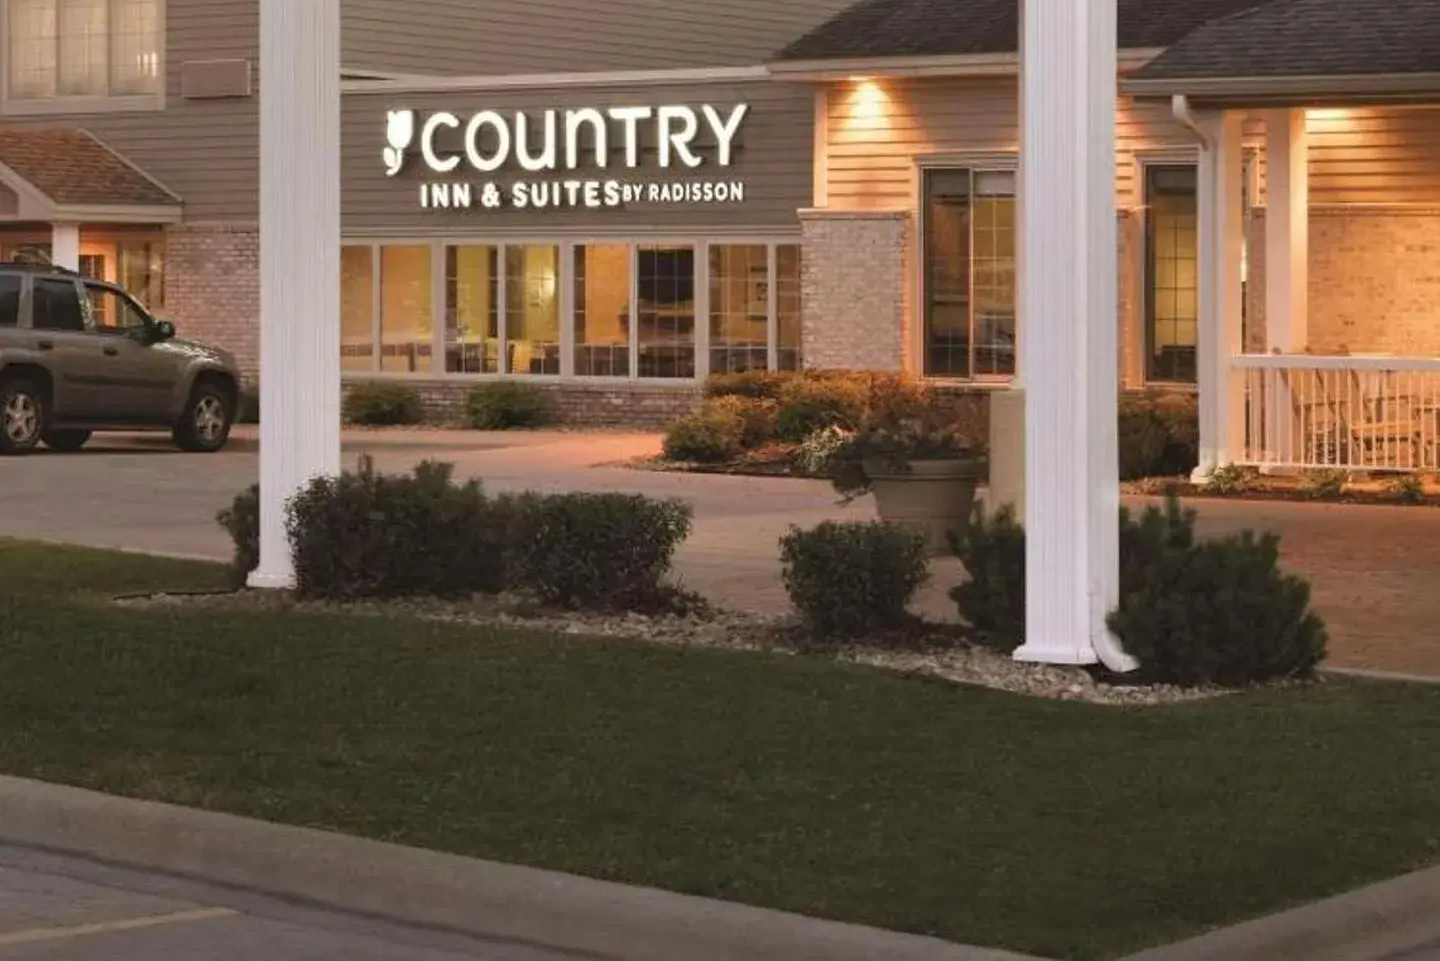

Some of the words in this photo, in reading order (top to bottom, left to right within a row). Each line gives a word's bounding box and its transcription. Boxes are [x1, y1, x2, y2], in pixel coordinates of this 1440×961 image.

[420, 103, 748, 172] COUNTRY
[420, 182, 470, 208] INN
[481, 181, 500, 207] &
[513, 180, 621, 207] SUITES
[623, 184, 643, 203] BY
[648, 181, 744, 203] RADISSON
